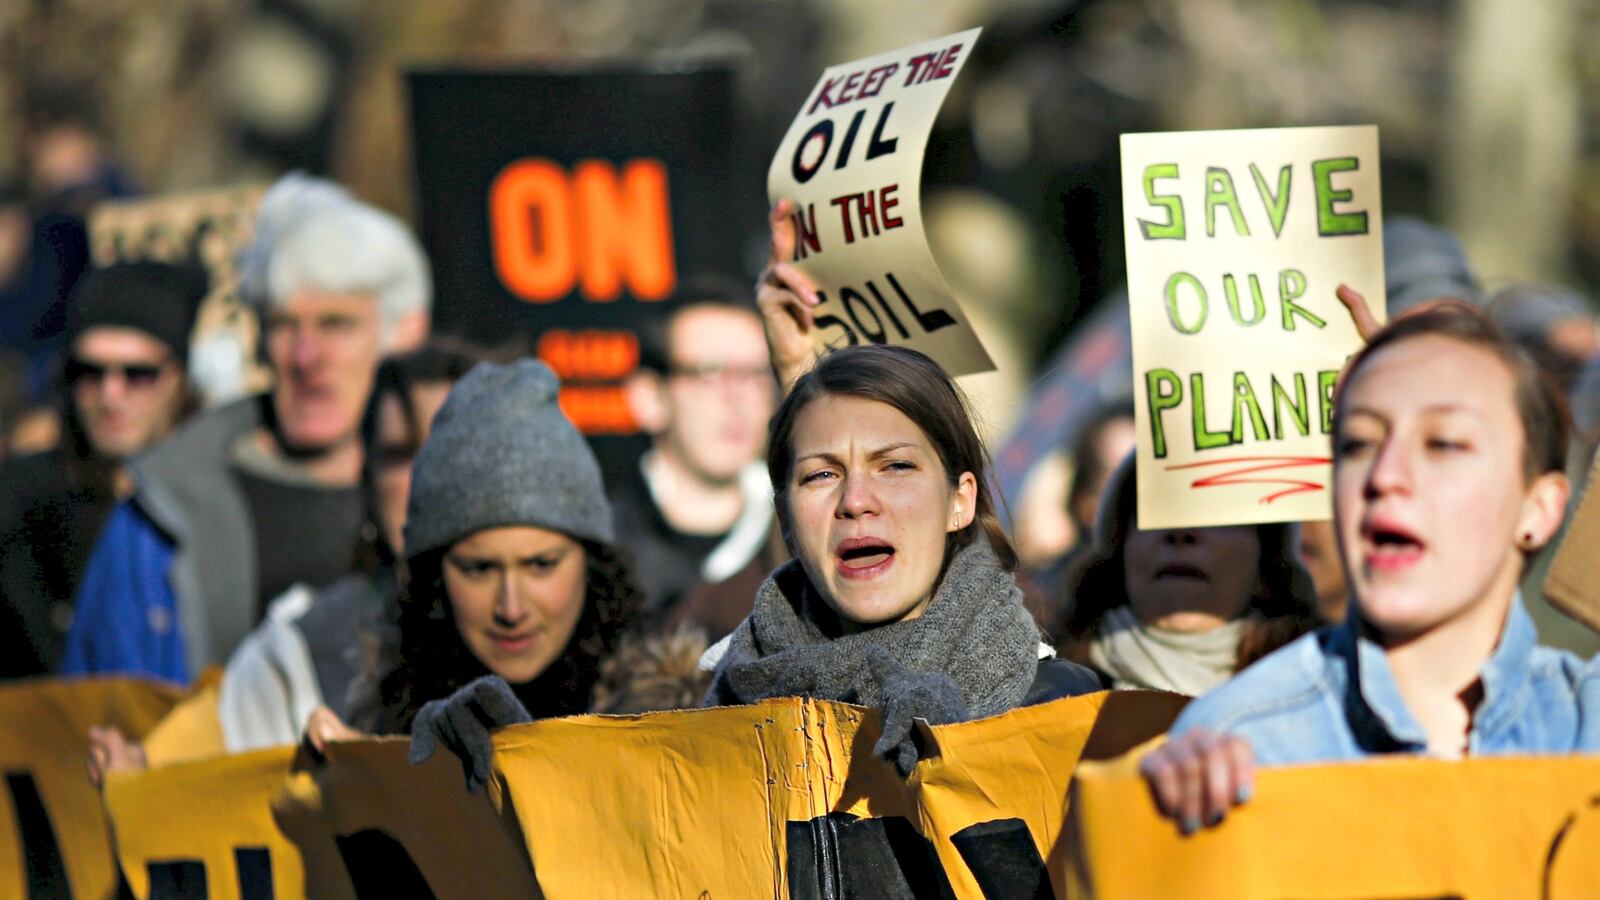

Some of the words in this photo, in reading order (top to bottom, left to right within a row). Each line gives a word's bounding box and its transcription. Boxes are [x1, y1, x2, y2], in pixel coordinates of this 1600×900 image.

[806, 62, 899, 116] KEEP
[903, 43, 964, 88] THE
[791, 101, 899, 184] OIL
[489, 157, 677, 302] ON
[831, 183, 904, 244] THE
[1136, 157, 1369, 240] SAVE
[811, 272, 957, 352] SOIL
[1164, 269, 1327, 335] OUR
[1145, 355, 1352, 459] PLANE
